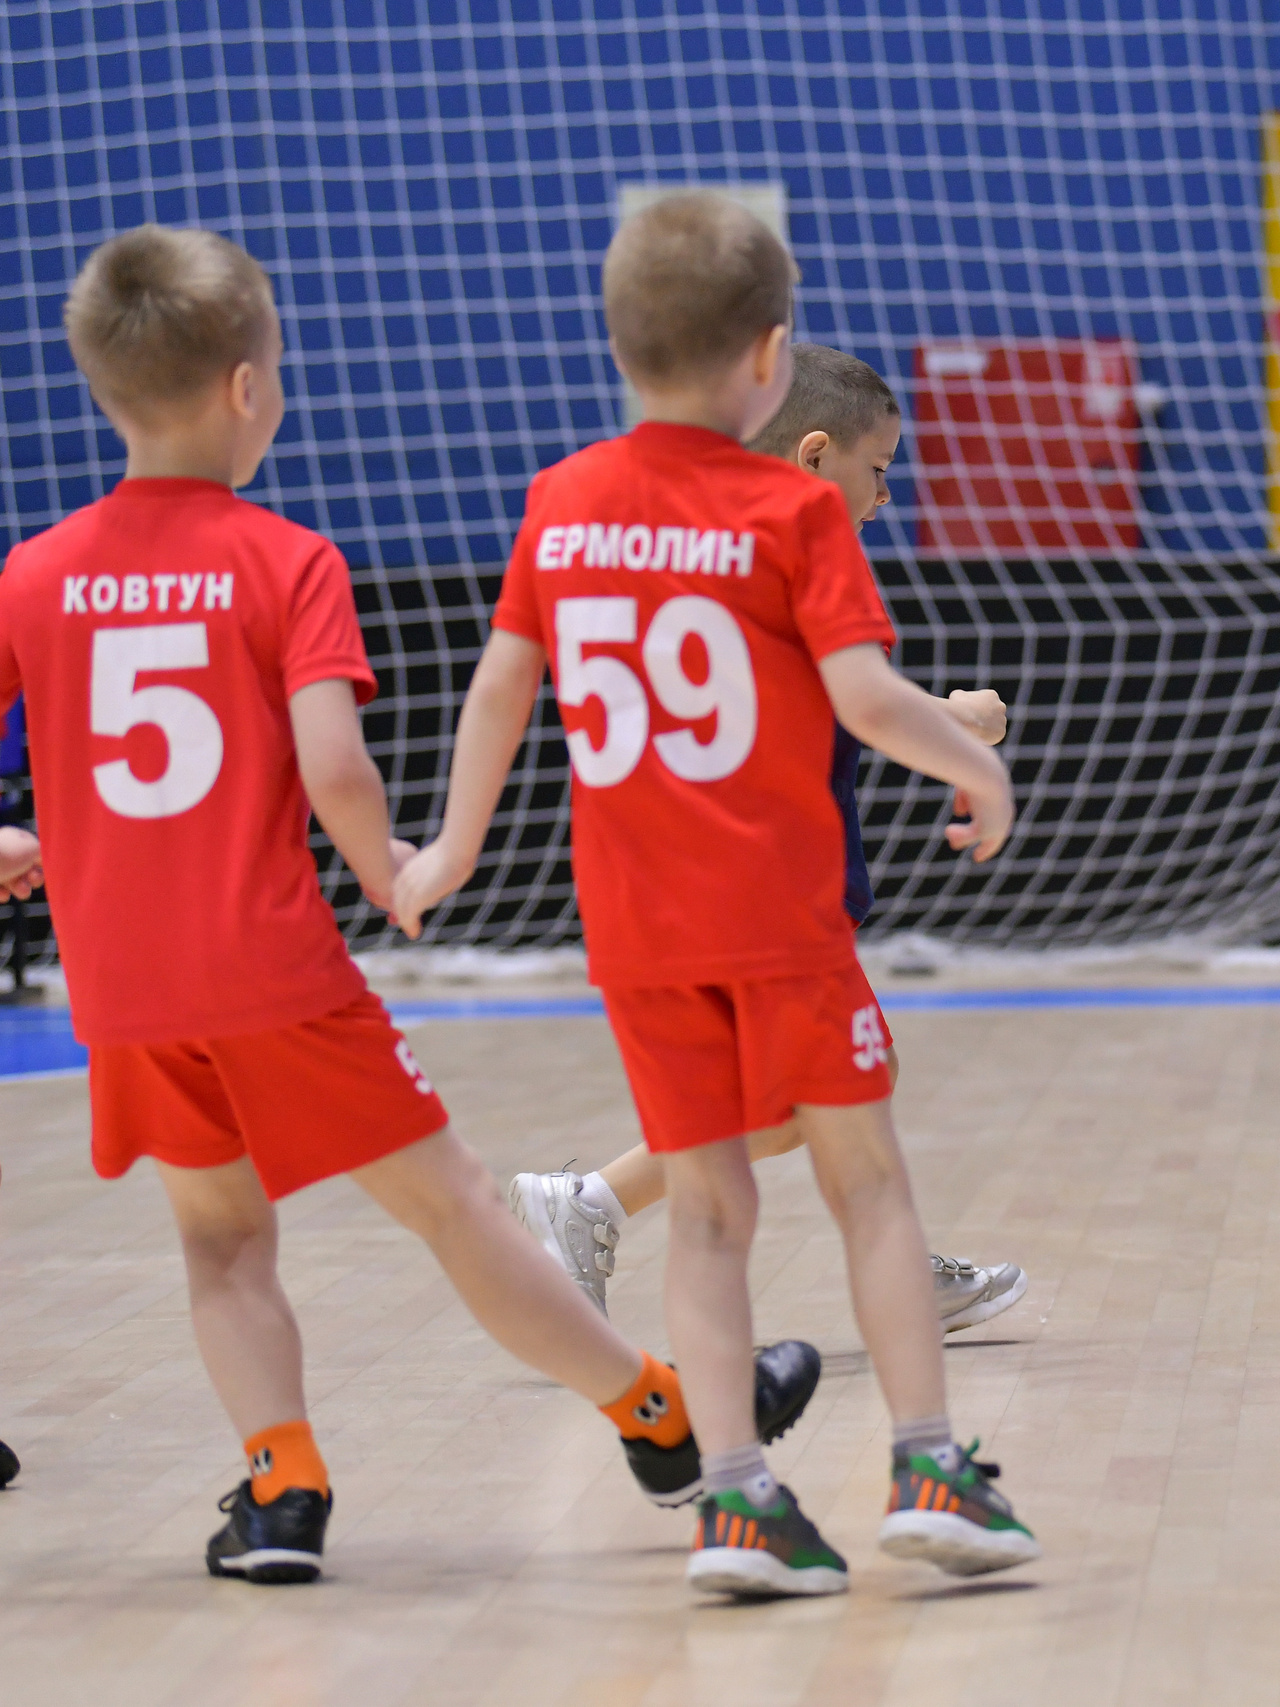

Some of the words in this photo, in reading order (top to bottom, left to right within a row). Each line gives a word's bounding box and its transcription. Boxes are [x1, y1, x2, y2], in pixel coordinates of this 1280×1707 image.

[64, 572, 234, 614] КОВТУН
[536, 522, 755, 577] ЕРМОЛИН
[90, 622, 224, 819] 5
[555, 596, 758, 787] 59
